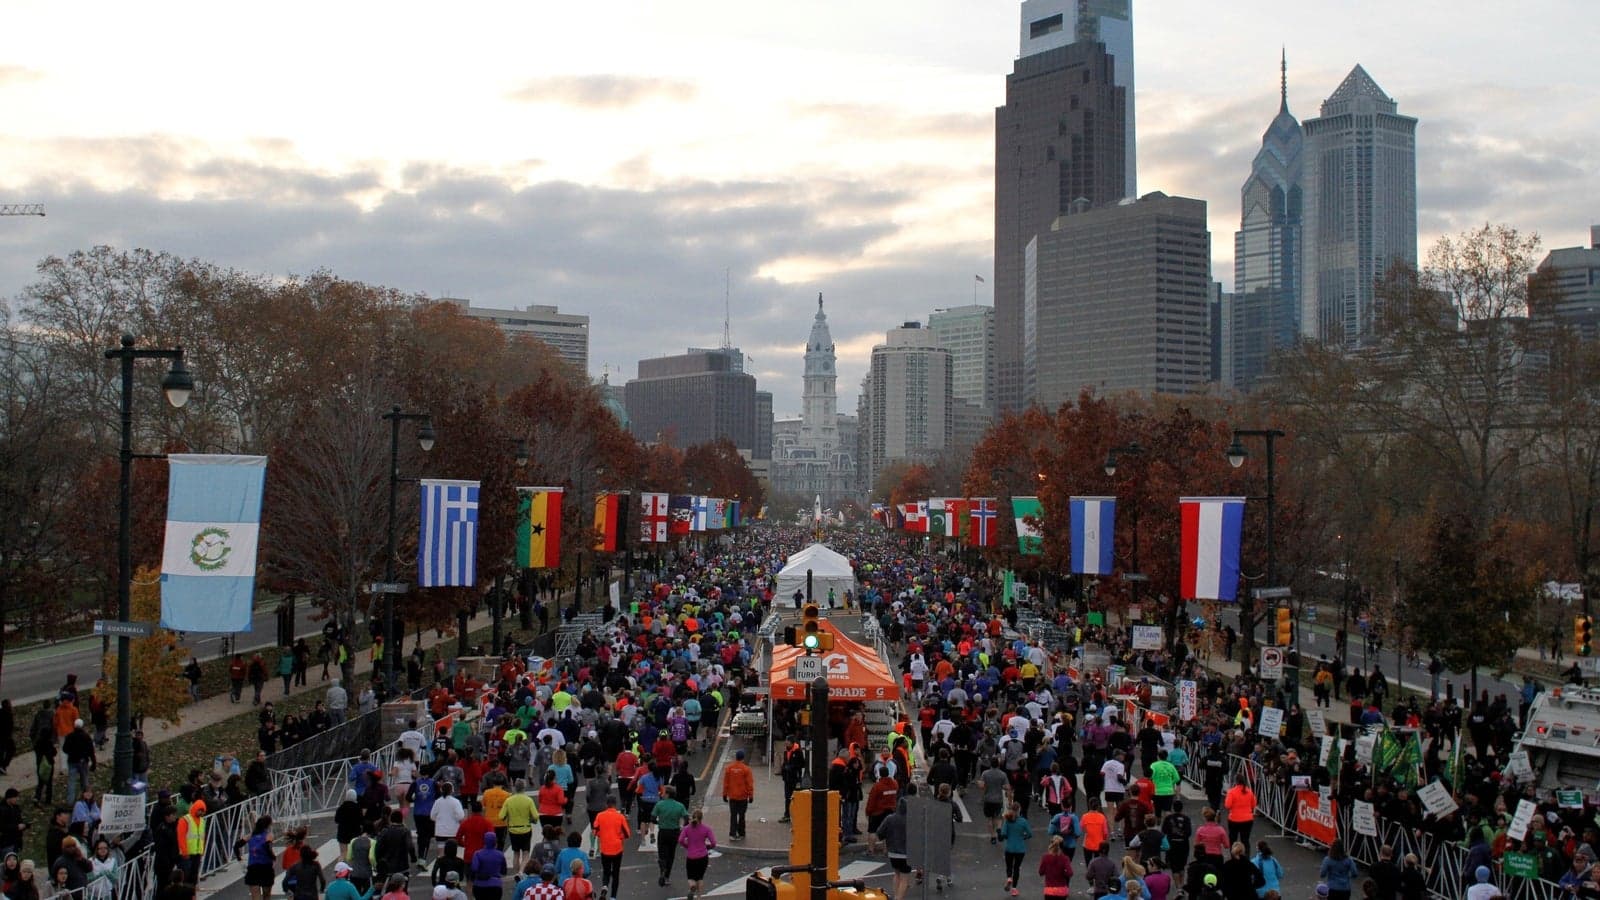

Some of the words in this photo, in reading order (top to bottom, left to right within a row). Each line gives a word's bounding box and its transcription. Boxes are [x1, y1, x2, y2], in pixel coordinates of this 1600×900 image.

[106, 625, 145, 634] GUATEMALA
[803, 660, 815, 669] NO
[797, 671, 821, 679] TURNS
[786, 686, 795, 695] G
[876, 687, 885, 696] G
